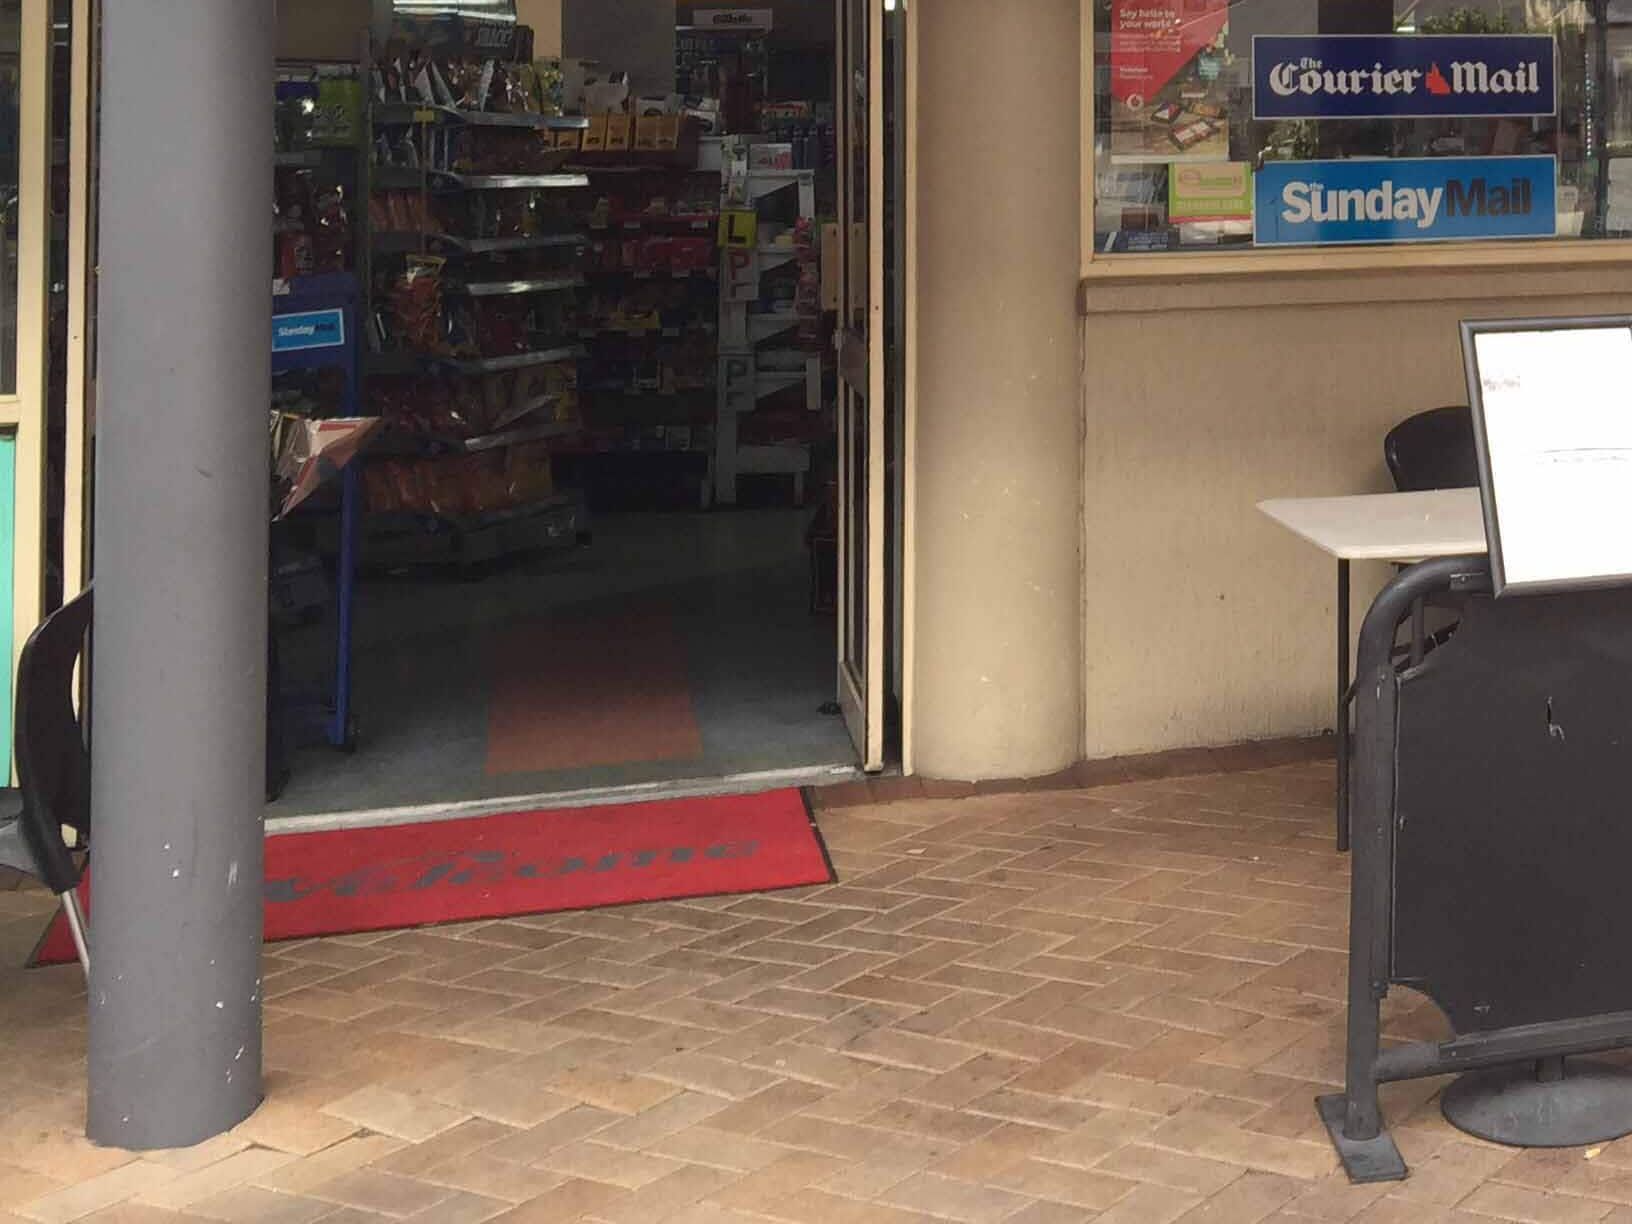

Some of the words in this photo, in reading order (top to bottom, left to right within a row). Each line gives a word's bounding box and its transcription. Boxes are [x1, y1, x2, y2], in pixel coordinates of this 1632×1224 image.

[1119, 8, 1137, 20] Say
[1299, 56, 1323, 70] The
[1269, 61, 1422, 97] Courier
[1450, 61, 1540, 94] Mail
[1281, 180, 1443, 229] Sunday
[1446, 178, 1532, 217] Mail
[728, 214, 747, 243] L
